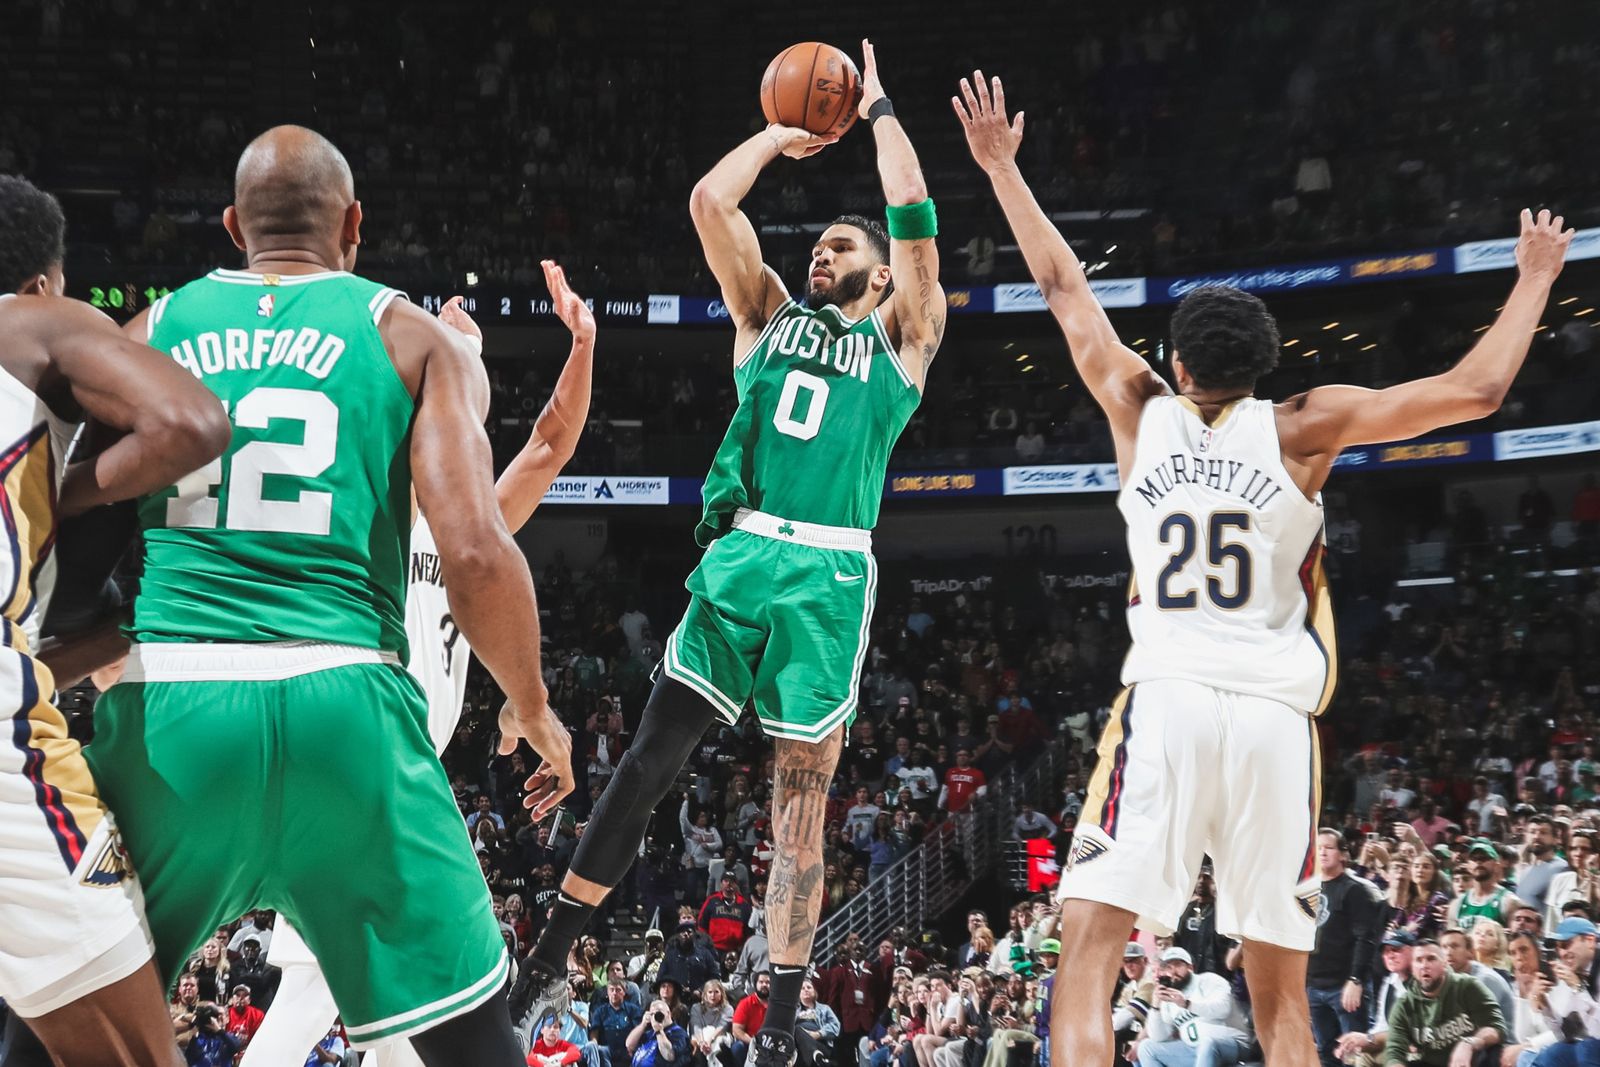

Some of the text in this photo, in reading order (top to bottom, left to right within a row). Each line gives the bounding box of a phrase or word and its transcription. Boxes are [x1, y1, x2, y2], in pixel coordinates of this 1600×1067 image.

[501, 296, 511, 315] 2
[606, 300, 643, 316] FOULS
[170, 326, 346, 380] HORFORD
[765, 315, 875, 384] BOSTON
[772, 368, 831, 441] 0
[1135, 453, 1244, 510] MURPHY
[1157, 509, 1253, 612] 25
